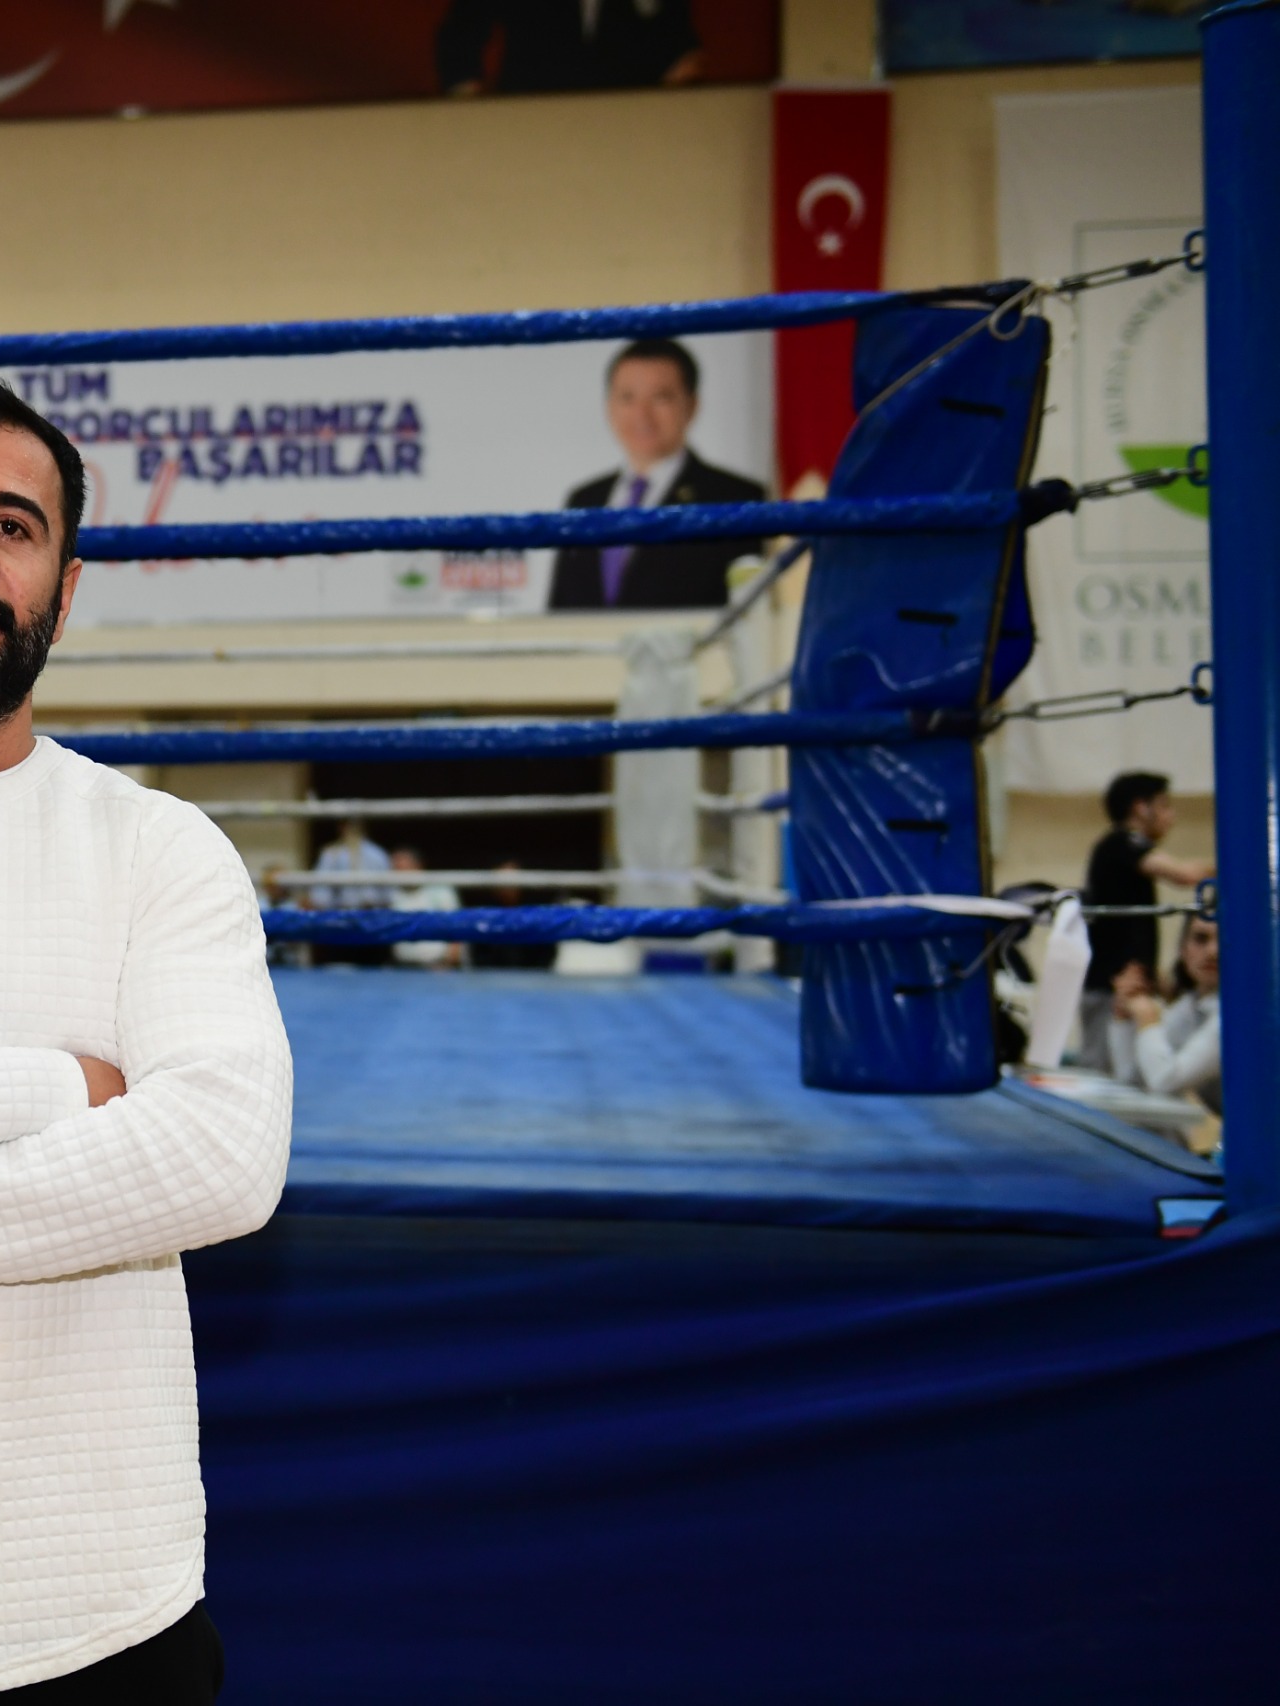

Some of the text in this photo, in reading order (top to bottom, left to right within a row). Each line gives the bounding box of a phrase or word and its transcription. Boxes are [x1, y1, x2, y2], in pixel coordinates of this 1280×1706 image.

[17, 366, 110, 402] TÜM
[48, 401, 421, 441] PORCULARIMIZA
[136, 442, 421, 484] BAŞARILAR
[1074, 573, 1208, 621] OSM
